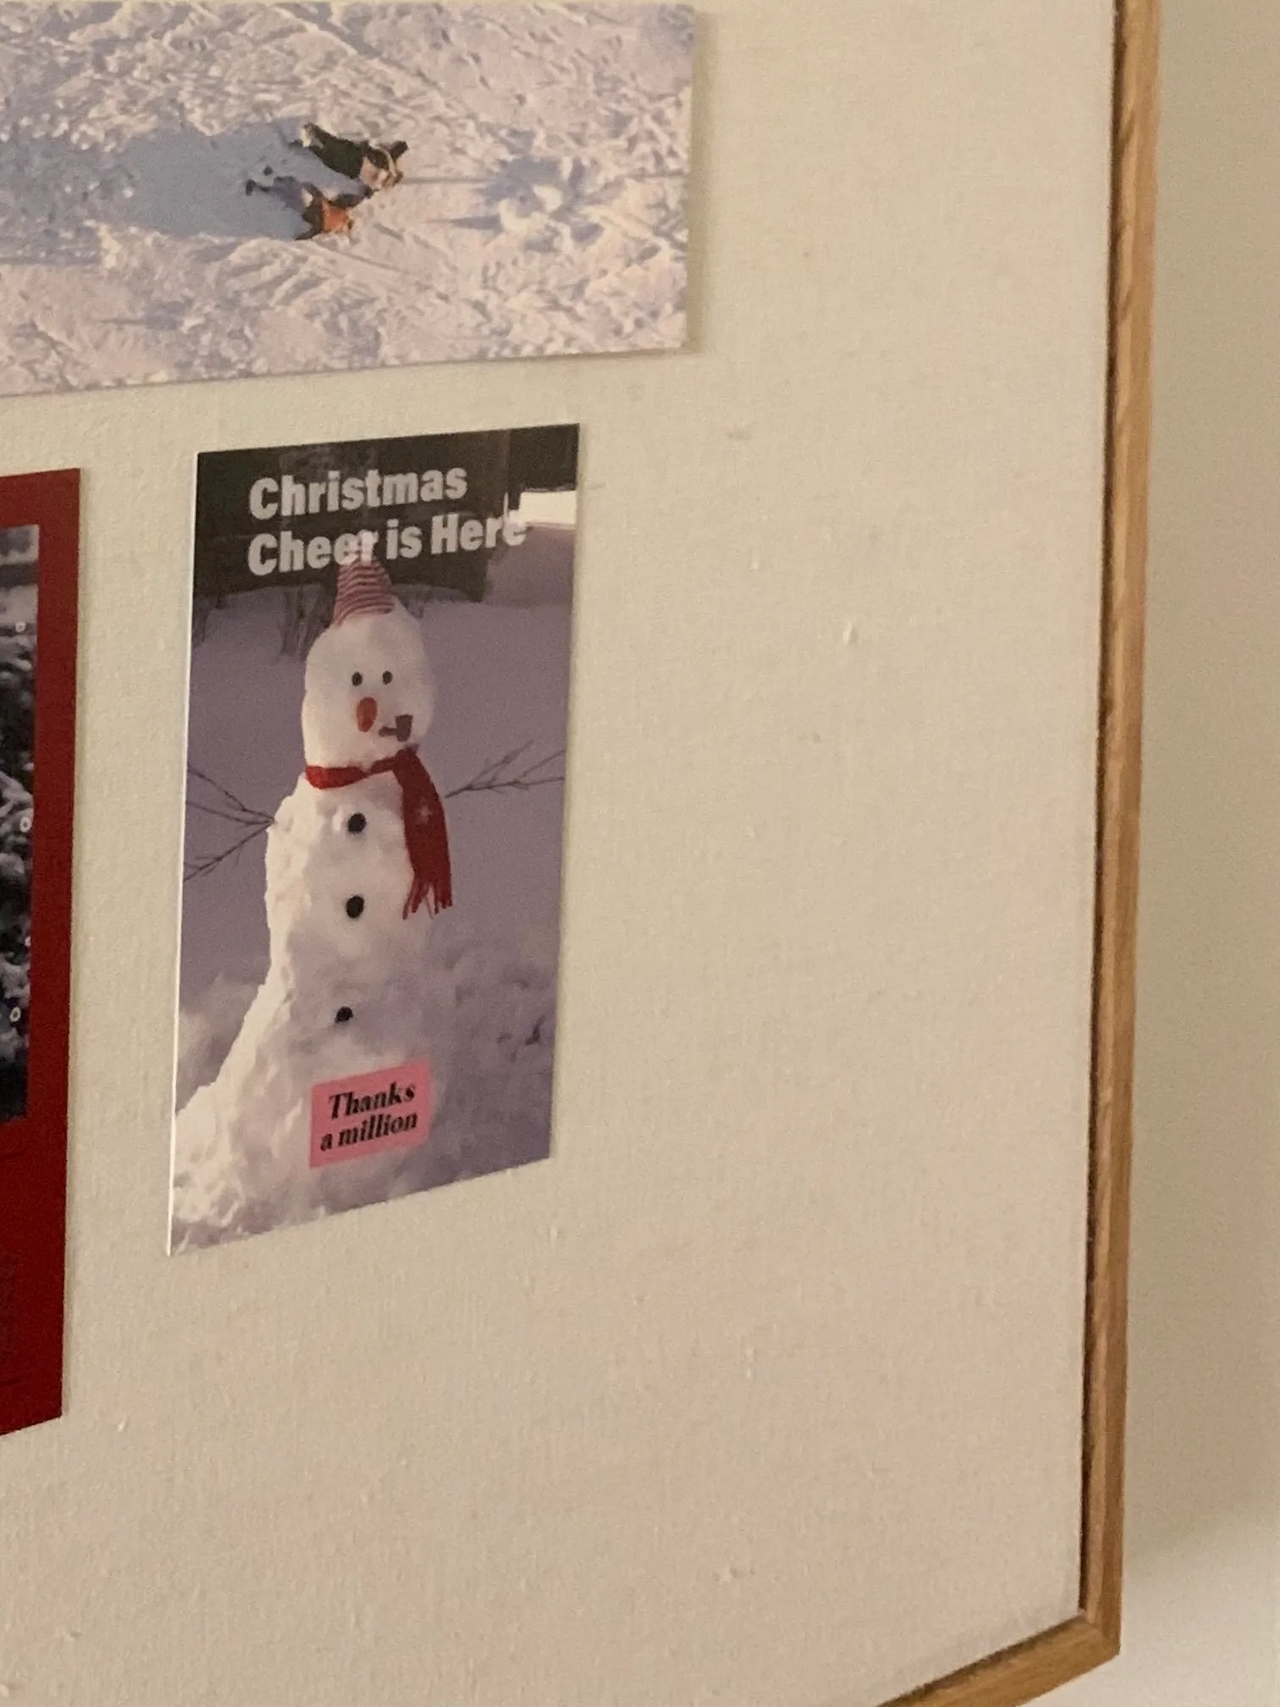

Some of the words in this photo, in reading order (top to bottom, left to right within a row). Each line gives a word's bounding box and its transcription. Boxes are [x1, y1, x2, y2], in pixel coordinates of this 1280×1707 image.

[249, 467, 467, 520] Christmas
[247, 529, 379, 576] Cheer
[386, 518, 422, 560] is
[431, 510, 527, 554] Here
[329, 1081, 417, 1119] Thanks
[320, 1132, 333, 1151] a
[338, 1112, 418, 1146] million
